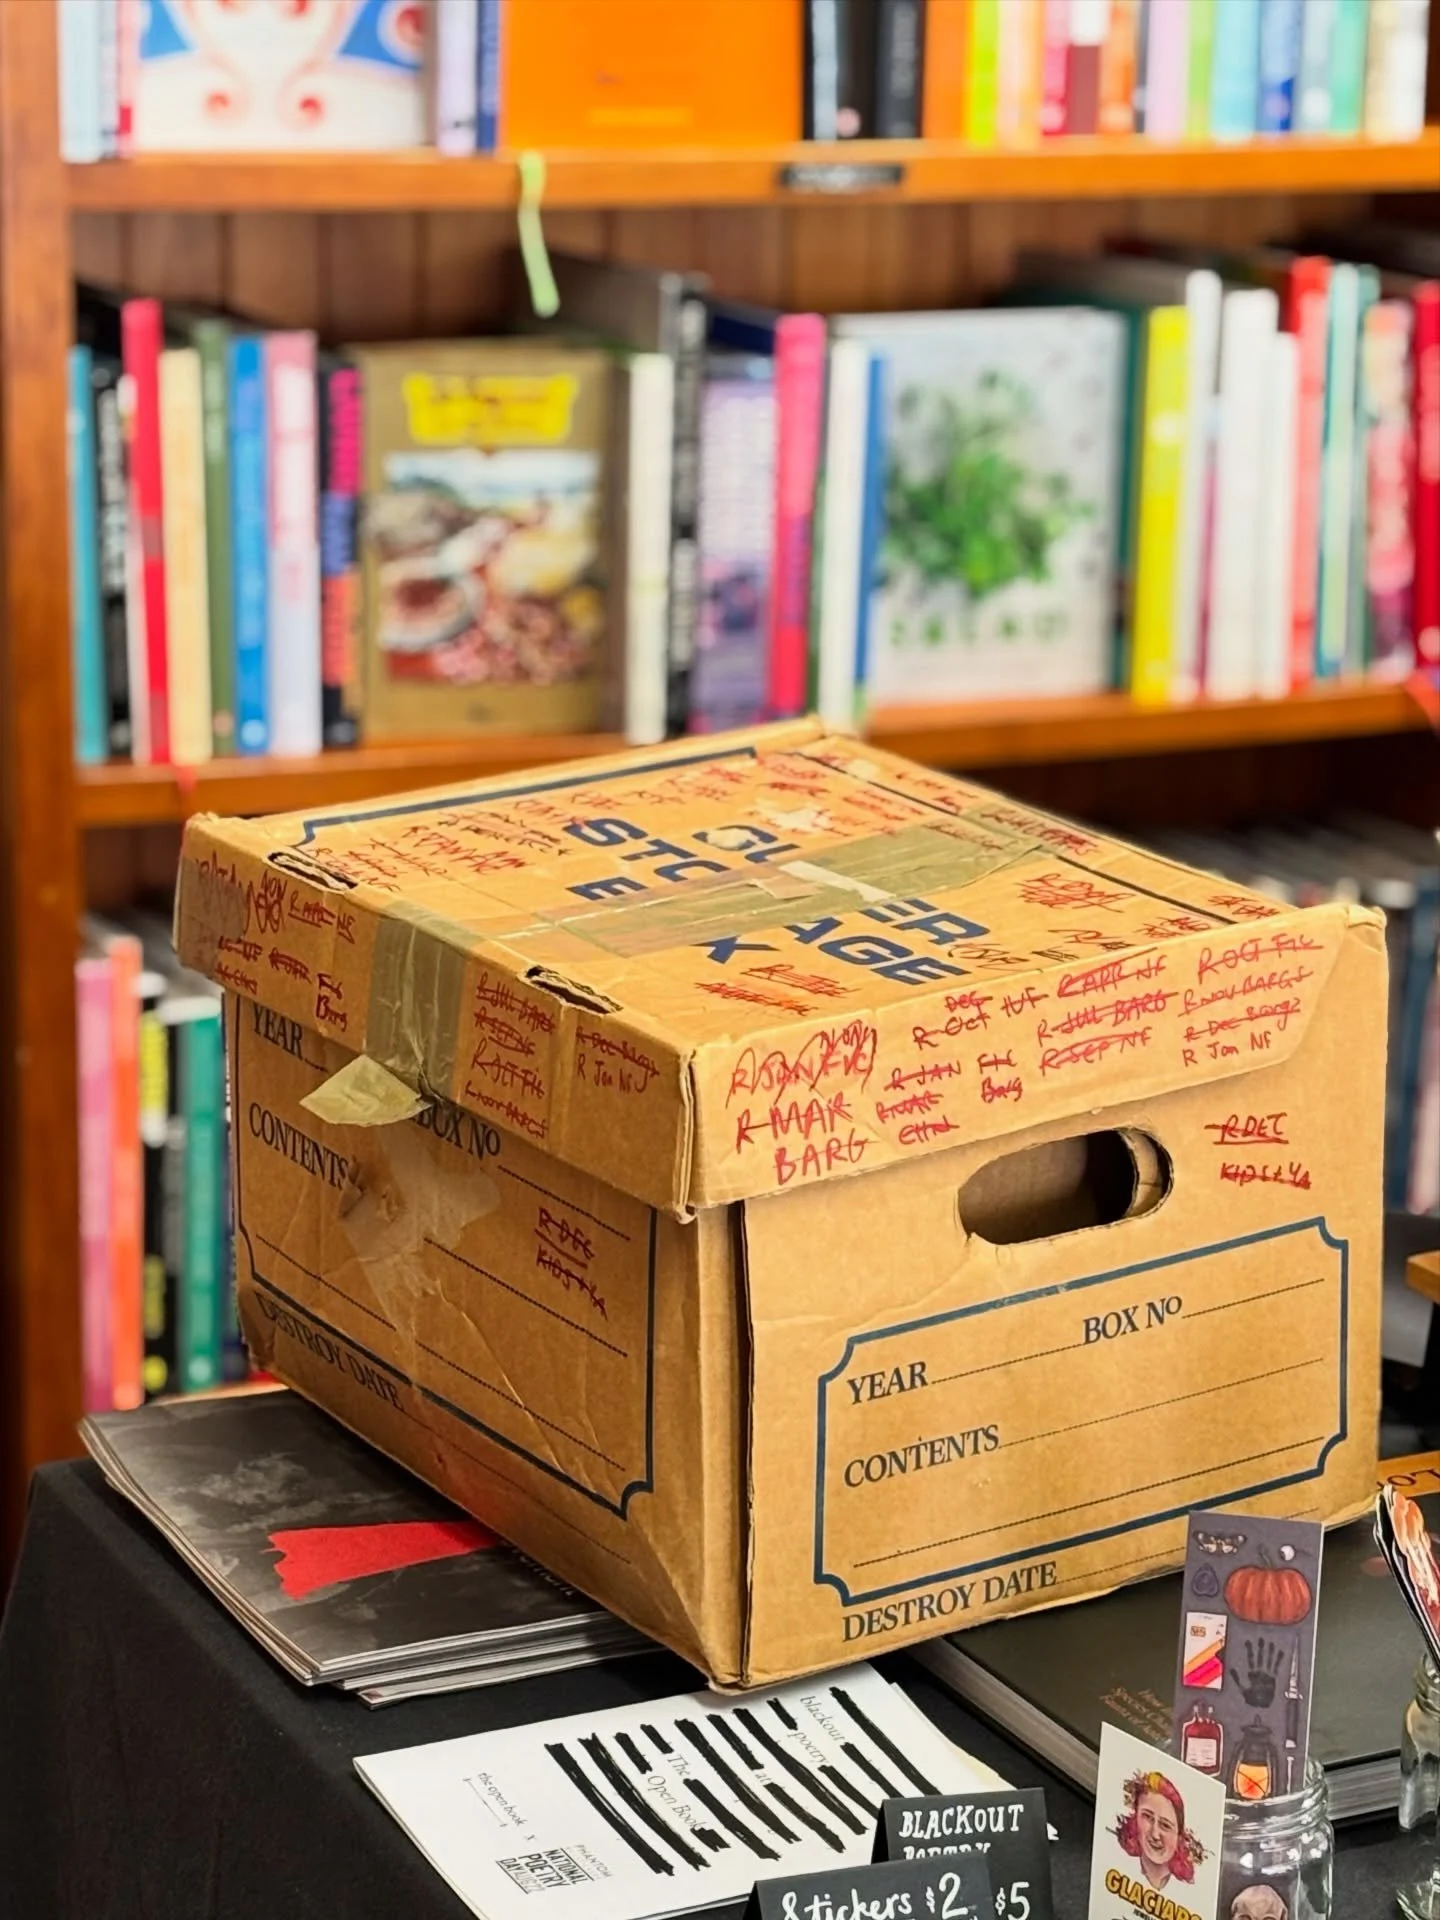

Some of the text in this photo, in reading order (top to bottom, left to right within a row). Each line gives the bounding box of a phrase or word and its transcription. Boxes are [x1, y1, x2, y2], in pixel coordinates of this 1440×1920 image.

[562, 817, 972, 986] STOAGE
[692, 824, 990, 946] SUER
[252, 1002, 304, 1055] YEAR
[1182, 1048, 1199, 1067] R
[249, 1101, 350, 1191] CONTENTS
[773, 1128, 871, 1187] BARG
[847, 1360, 928, 1405] YEAR
[1083, 1306, 1140, 1346] BOX
[843, 1424, 1000, 1488] CONTENTS
[842, 1560, 1058, 1643] DESTROY DATE
[800, 1695, 846, 1743] blackout
[667, 1753, 691, 1778] The
[786, 1729, 831, 1765] poetry
[647, 1774, 677, 1806] Open
[898, 1804, 1025, 1840] BLACKOUT
[500, 1857, 525, 1873] DAY
[517, 1852, 571, 1888] POETRY
[542, 1849, 588, 1885] NATIONAL
[925, 1871, 969, 1920] $2
[994, 1881, 1031, 1920] $5
